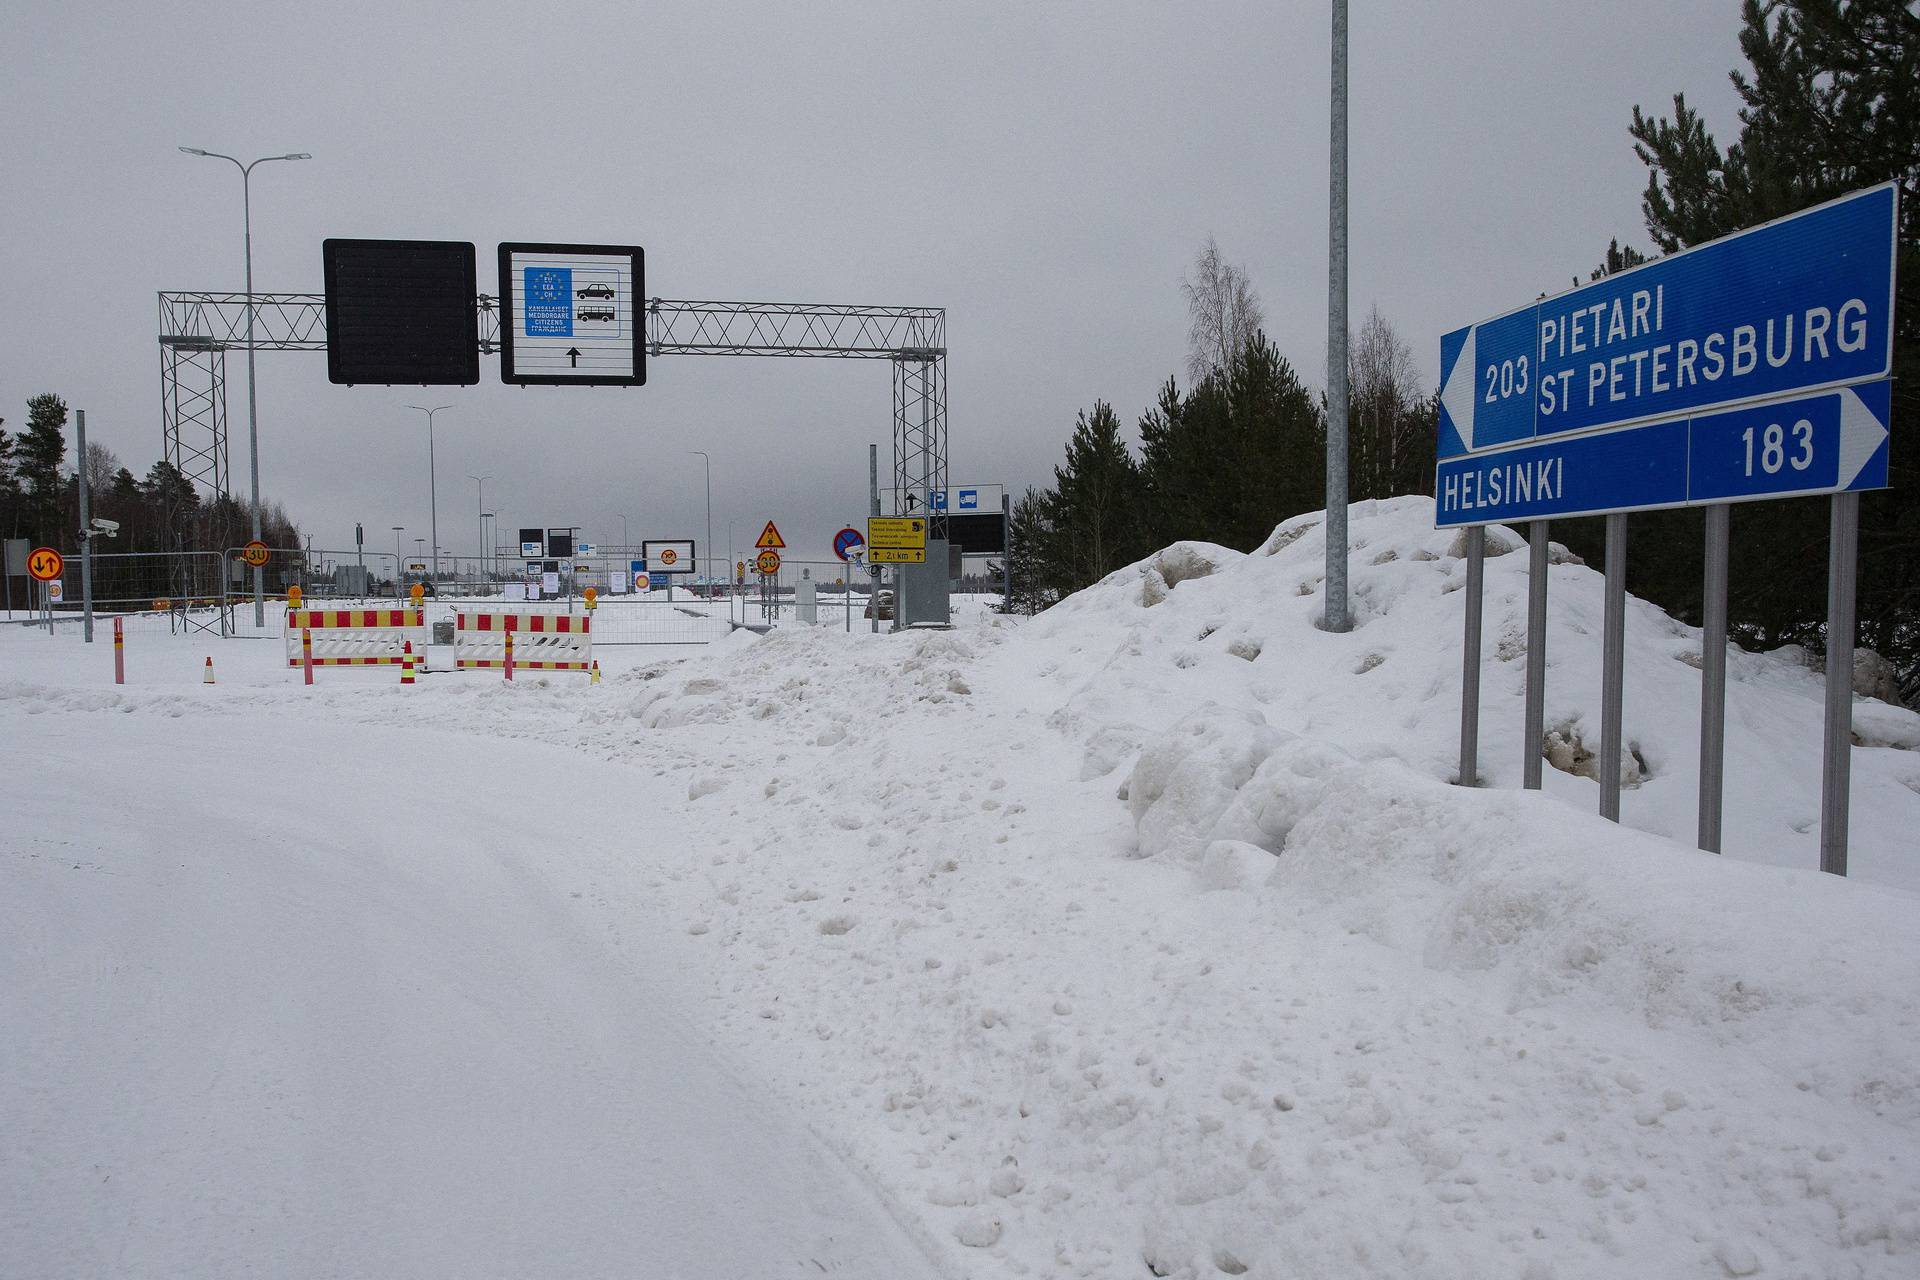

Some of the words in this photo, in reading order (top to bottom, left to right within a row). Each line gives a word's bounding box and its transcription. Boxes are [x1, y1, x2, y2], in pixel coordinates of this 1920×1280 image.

[1541, 285, 1664, 362] PIETARI
[1485, 354, 1529, 404] 203
[1540, 369, 1575, 416] ST
[1588, 298, 1868, 407] PETERSBURG
[1742, 419, 1814, 477] 183
[1444, 457, 1563, 512] HELSINKI
[249, 546, 265, 560] 30
[761, 555, 776, 569] 30
[897, 551, 909, 560] km
